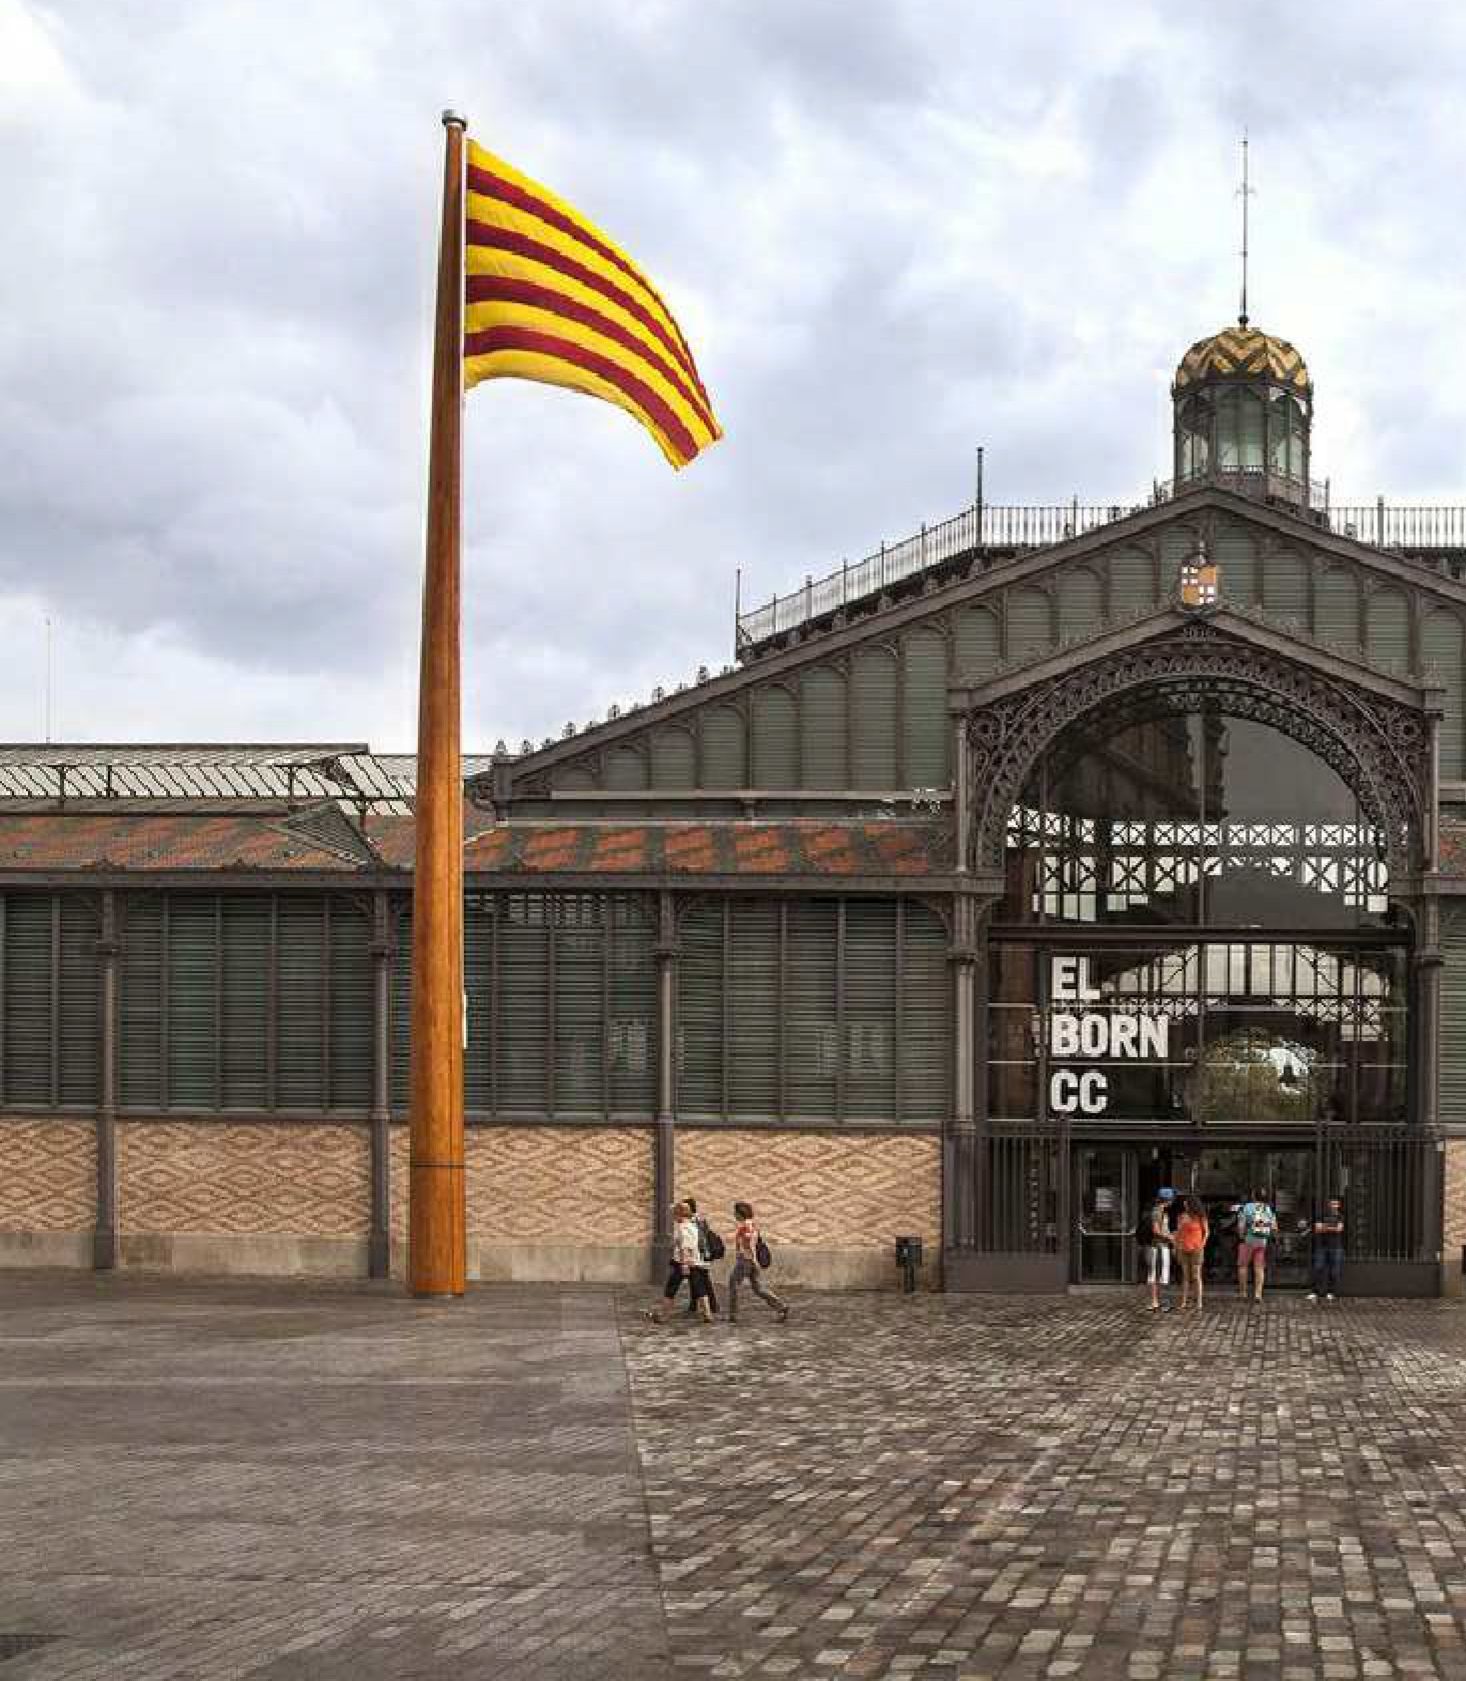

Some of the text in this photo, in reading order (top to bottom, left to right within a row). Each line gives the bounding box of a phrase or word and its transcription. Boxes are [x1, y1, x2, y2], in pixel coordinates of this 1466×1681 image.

[1051, 956, 1101, 999] EL
[1051, 1015, 1168, 1058] BORN
[1051, 1071, 1108, 1113] CC
